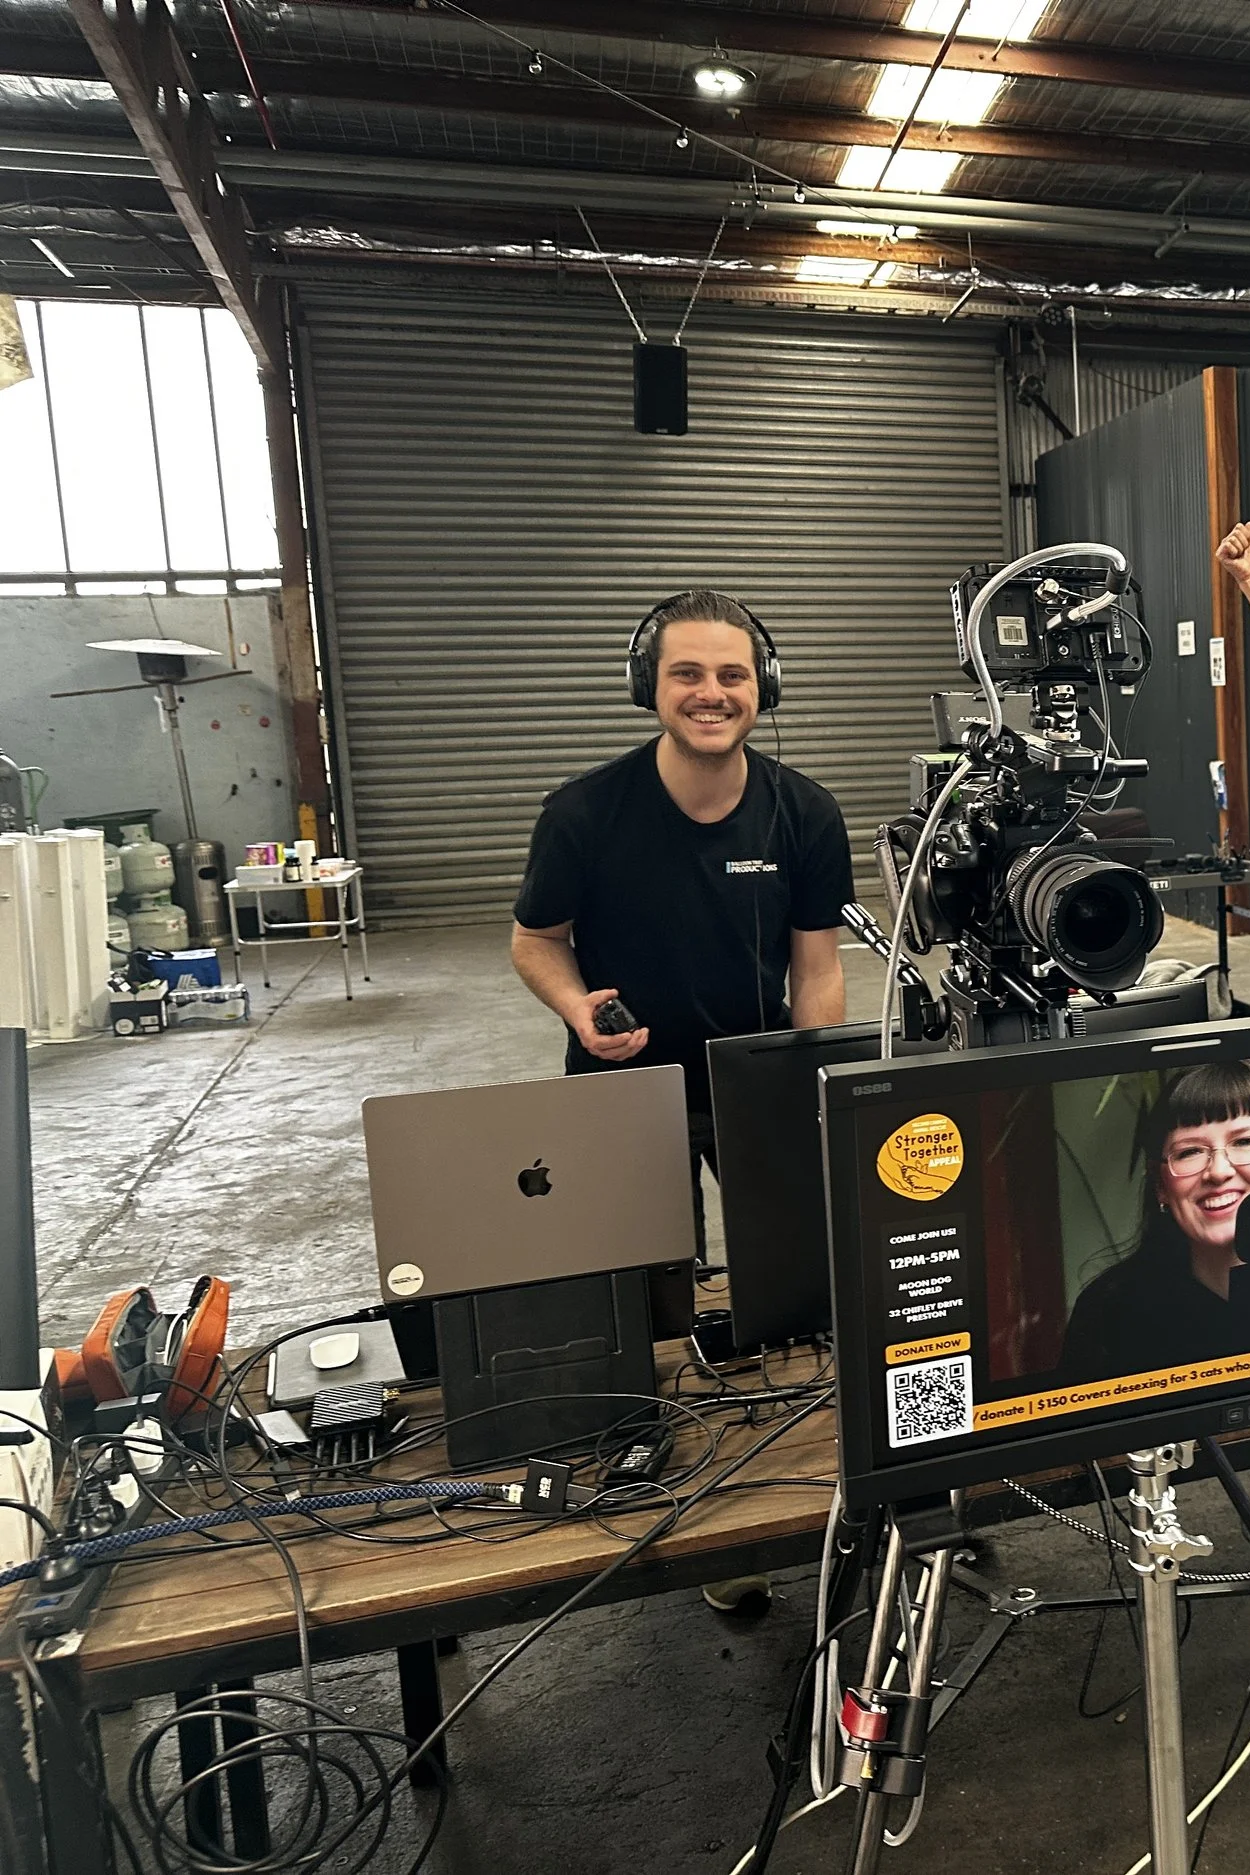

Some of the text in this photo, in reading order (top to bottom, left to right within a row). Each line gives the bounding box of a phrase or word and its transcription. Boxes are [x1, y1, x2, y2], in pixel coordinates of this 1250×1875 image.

[895, 1132, 955, 1149] Stronger
[903, 1144, 959, 1161] Together
[928, 1155, 961, 1168] APPEAL
[889, 1233, 917, 1245] COME
[917, 1230, 940, 1241] JOIN
[888, 1248, 961, 1270] 12PM-5PM
[898, 1275, 953, 1291] MOON DOG
[908, 1285, 943, 1298] WORLD
[888, 1298, 964, 1318] 32 CHIFLEY DRIVE
[906, 1309, 947, 1323] PRESTON
[894, 1338, 961, 1358] DONATE NOW
[1036, 1395, 1068, 1411] $150
[1069, 1388, 1111, 1404] Covers
[1113, 1376, 1168, 1396] desexing
[1169, 1372, 1188, 1386] for
[1189, 1370, 1199, 1381] 3
[1200, 1366, 1223, 1379] cats
